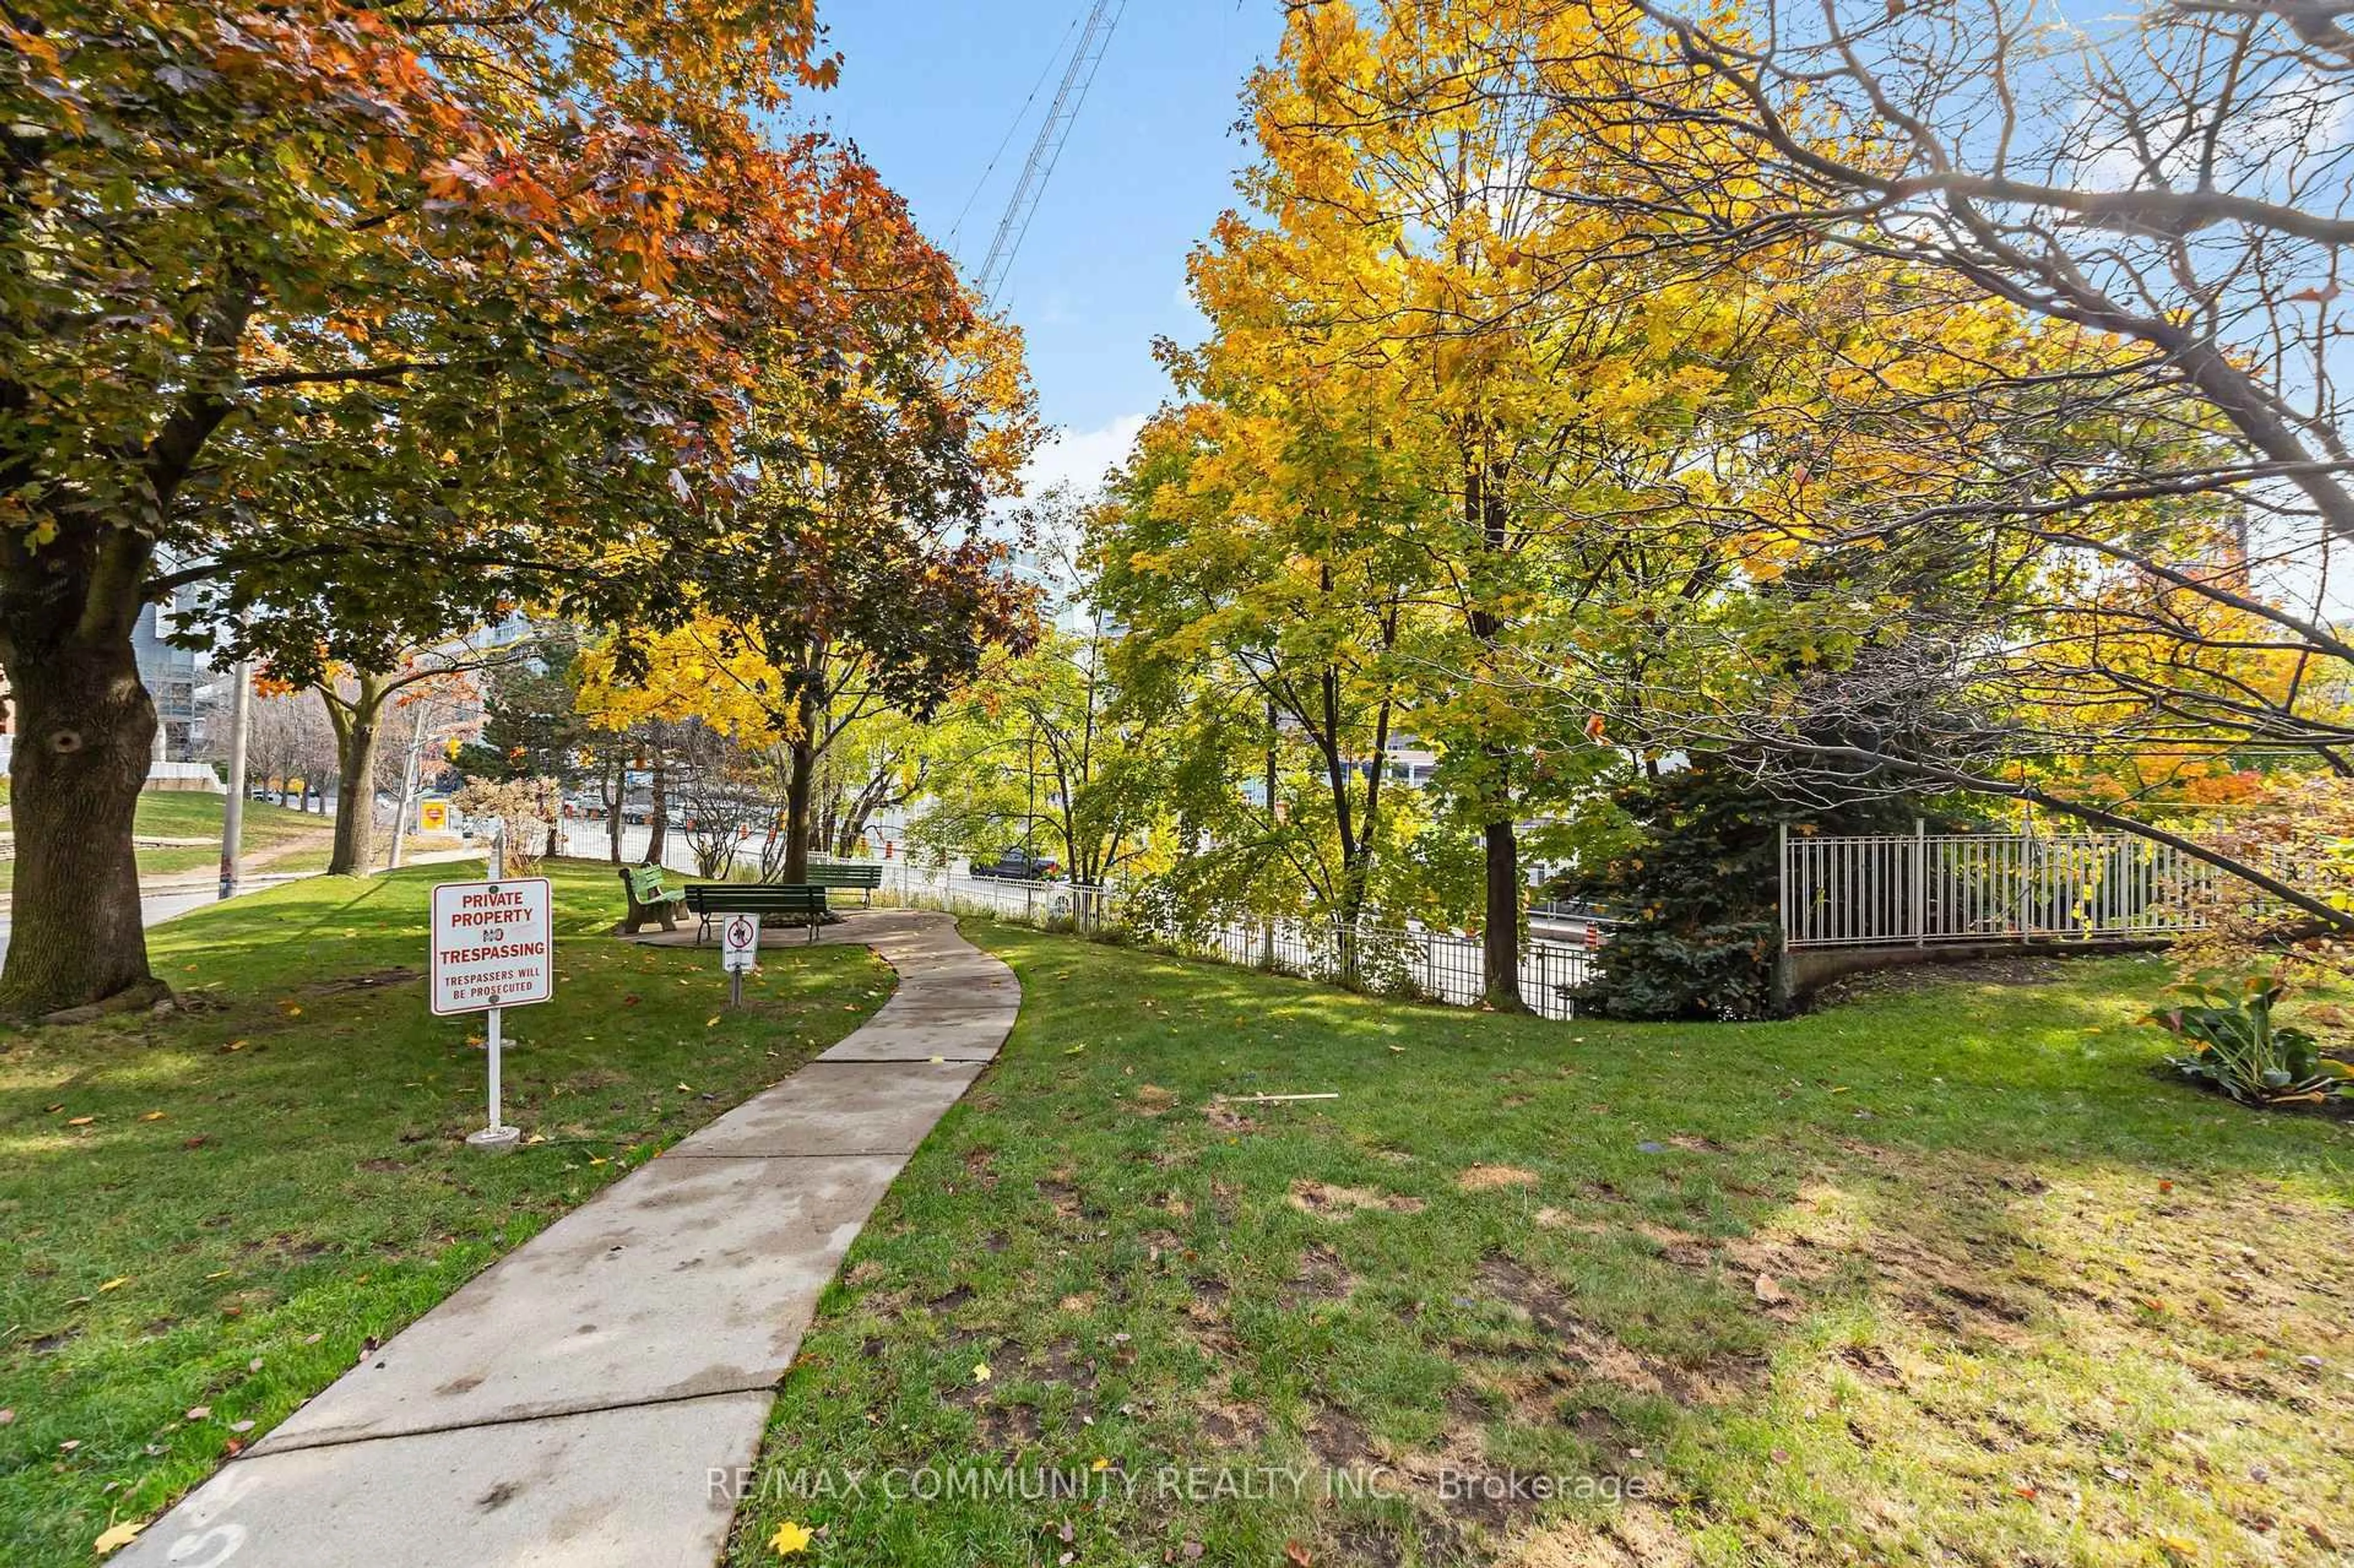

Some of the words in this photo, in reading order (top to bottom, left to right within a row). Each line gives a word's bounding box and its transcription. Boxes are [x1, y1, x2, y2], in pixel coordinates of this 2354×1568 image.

[462, 892, 523, 908] PRIVATE
[452, 909, 532, 927] PROPERTY
[483, 928, 504, 942] NO
[440, 942, 545, 964] TRESPASSING
[446, 970, 513, 986] TRESPASSERS
[519, 967, 540, 976] WILL
[453, 989, 465, 1000] BE
[471, 981, 532, 997] PROSECUTED
